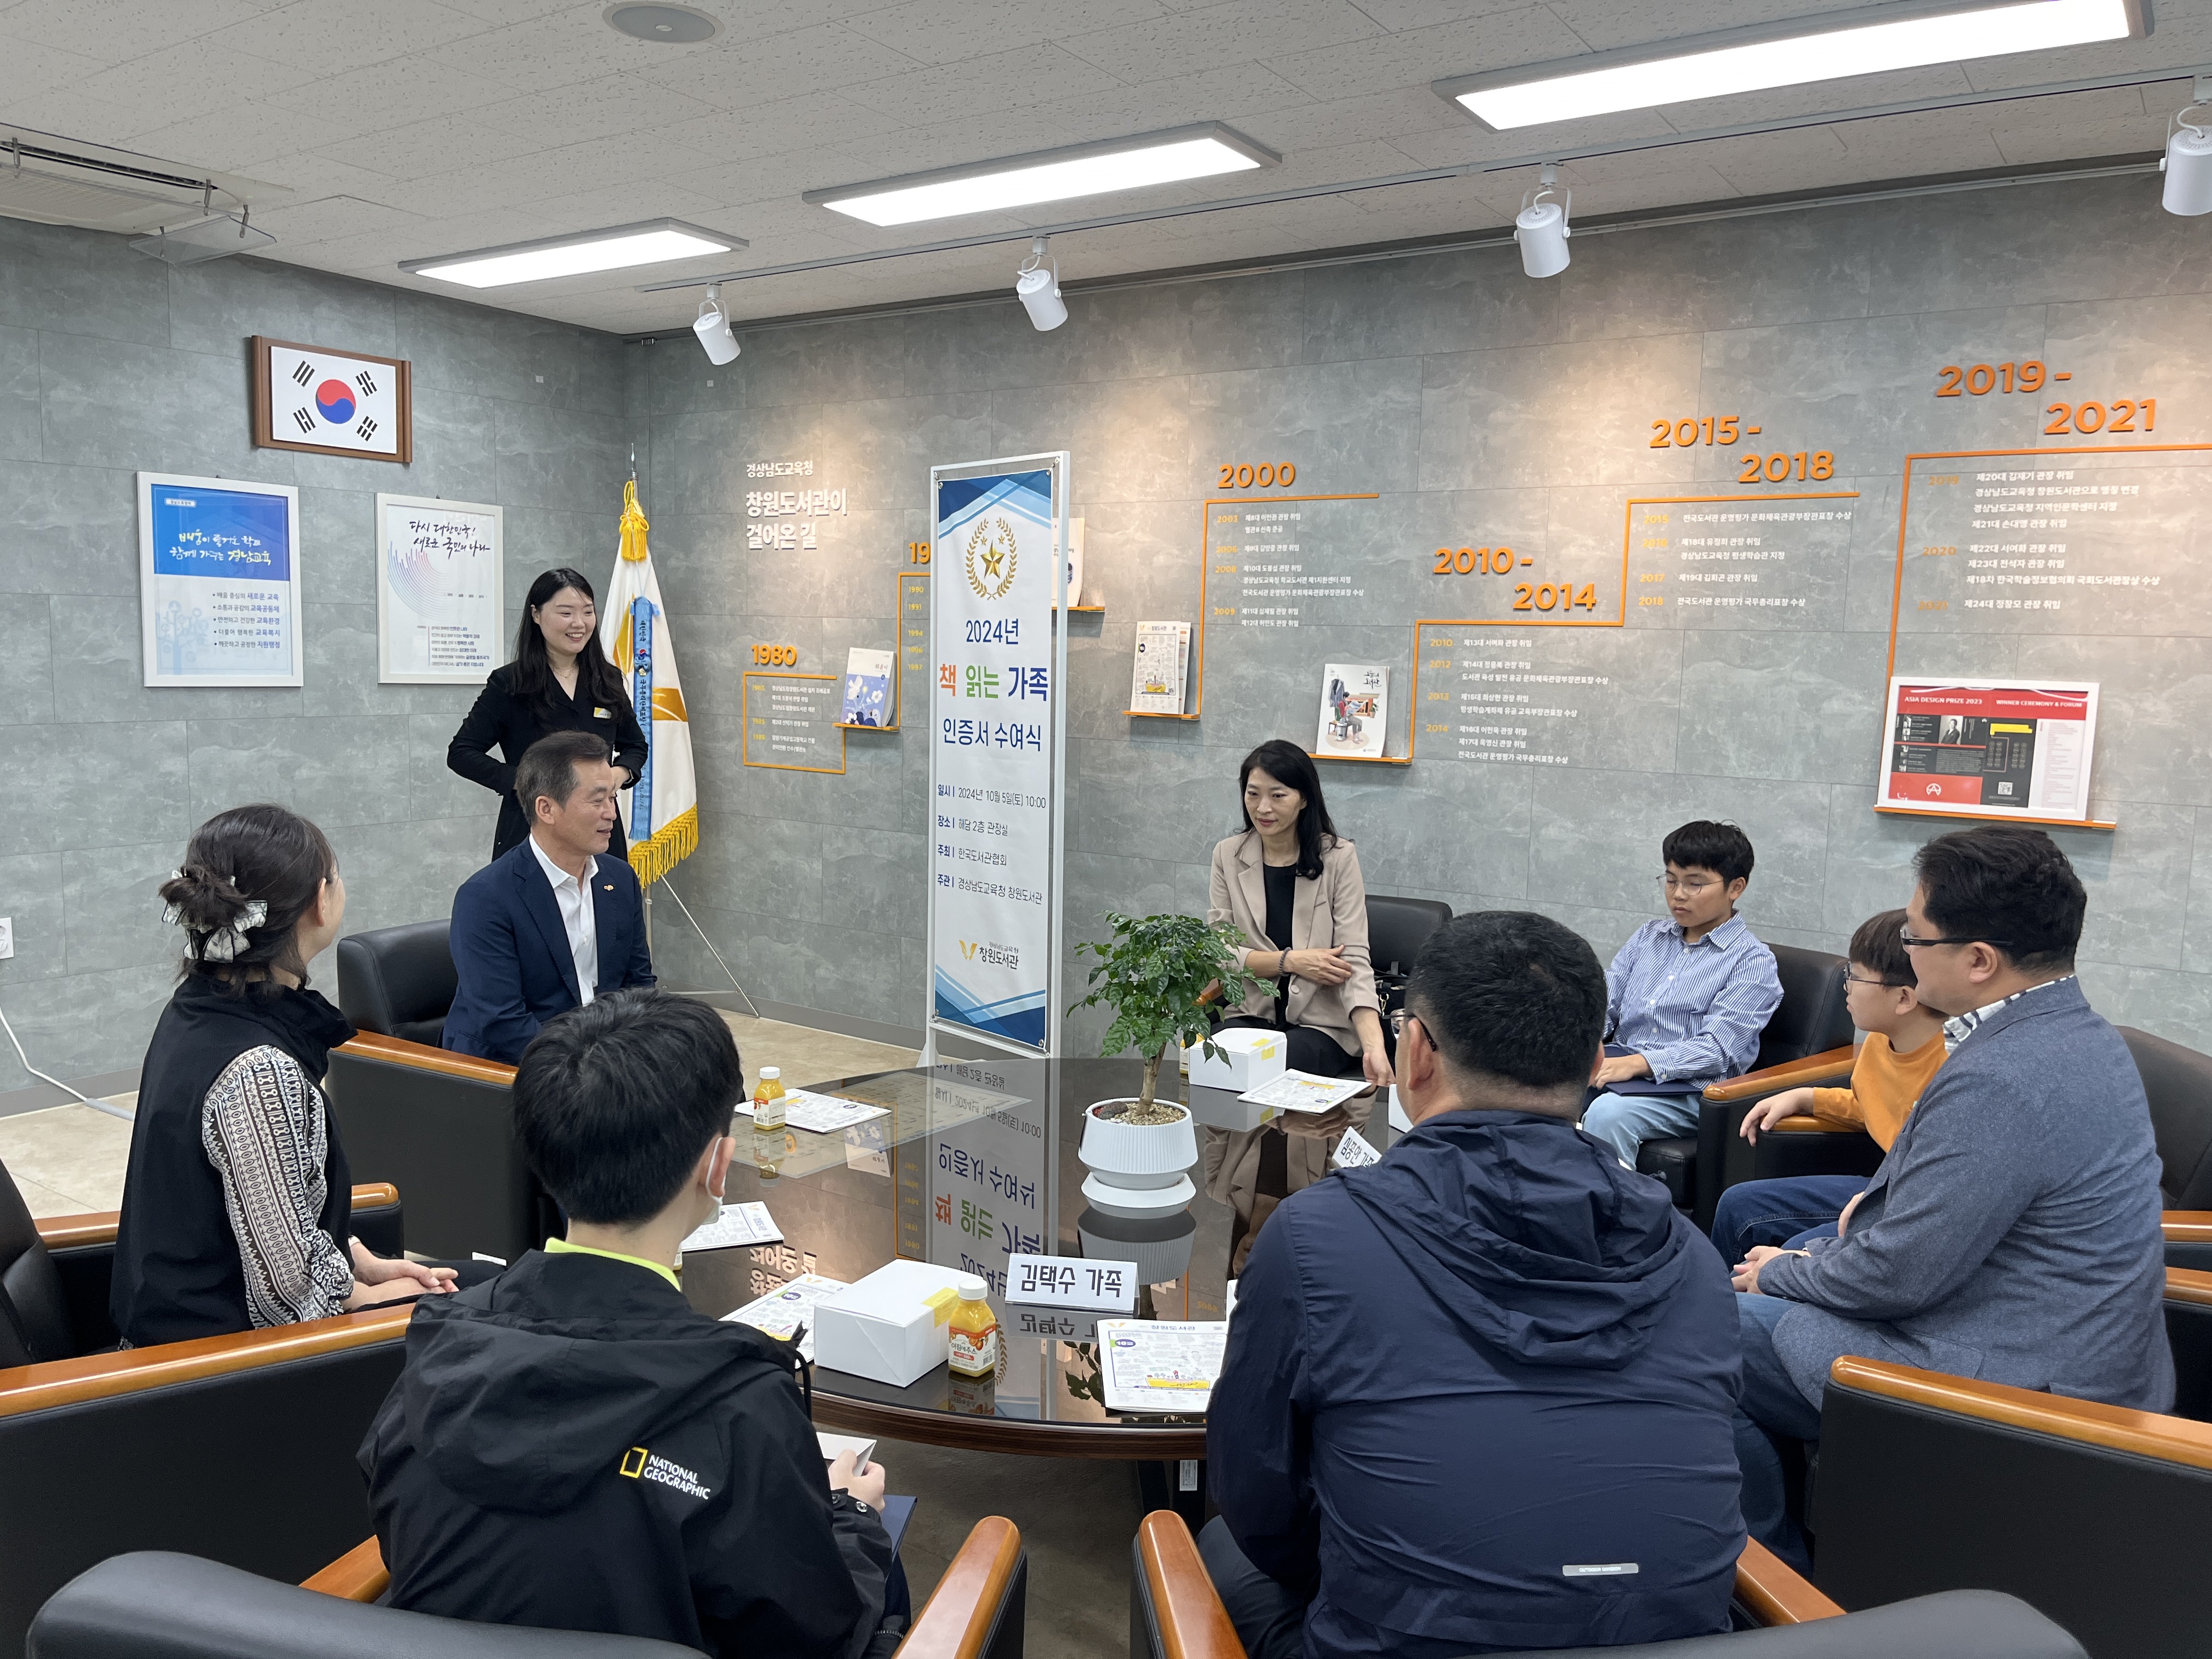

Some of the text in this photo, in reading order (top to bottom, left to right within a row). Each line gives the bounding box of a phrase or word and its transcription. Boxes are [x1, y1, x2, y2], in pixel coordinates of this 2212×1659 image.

[2044, 398, 2156, 436] 2021
[746, 460, 814, 478] 경상남도교육청
[1217, 461, 1296, 488] 2000
[1739, 450, 1834, 483] 2018
[1976, 472, 2007, 482] 제20대
[1975, 486, 2098, 497] 경상남도교육청 창원도서관으로
[746, 488, 848, 517] 창원도서관이
[1973, 503, 2034, 513] 경상남도교육청
[1644, 514, 1669, 524] 2015
[1683, 514, 1718, 523] 전국도서관
[1835, 511, 1852, 520] 수상
[1972, 520, 2000, 529] 제21대
[409, 520, 430, 533] 다시
[179, 528, 210, 545] 배움이
[746, 522, 817, 550] 걸어온 길
[1681, 538, 1705, 546] 제18대
[169, 546, 272, 566] 함께 경남교육
[414, 536, 490, 560] 새로운 국민의 나라
[1680, 551, 1785, 560] 경상남도교육청 지정
[1922, 544, 1999, 556] 2020 제22대
[1968, 560, 1997, 569] 제23대
[1640, 573, 1702, 583] 2017 제19대
[2141, 575, 2160, 585] 수상
[1513, 582, 1596, 610] 2014
[1677, 597, 1805, 607] 전국도서관 운영평가 수상
[1918, 600, 1994, 611] 2021 제24대
[966, 618, 1019, 645] 2024년
[1430, 639, 1453, 647] 2010
[751, 644, 797, 665] 1980
[1430, 660, 1451, 668] 2012
[939, 663, 1048, 702] 책 읽는 가족
[1595, 676, 1609, 685] 수상
[1564, 709, 1578, 718] 수상
[943, 718, 1042, 752] 인증서 수여식
[1426, 724, 1448, 732] 2014
[1458, 738, 1479, 746] 제17대
[1458, 751, 1488, 760] 전국도서관
[1555, 756, 1568, 764] 수상
[938, 784, 1046, 809] 일시 2024년 10월 5일(토) 10:00
[938, 815, 951, 828] 장소
[972, 820, 984, 834] 2층
[987, 822, 1008, 837] 관장실
[938, 844, 1007, 867] 주최 한국도서관협회
[937, 874, 1043, 906] 주관 경상남도교육청 창원도서관
[979, 946, 1019, 970] 창원도서관
[1020, 1264, 1122, 1298] 김택수 가족
[648, 1454, 698, 1485] NATIONAL
[644, 1466, 711, 1500] GEOGRAPHIC
